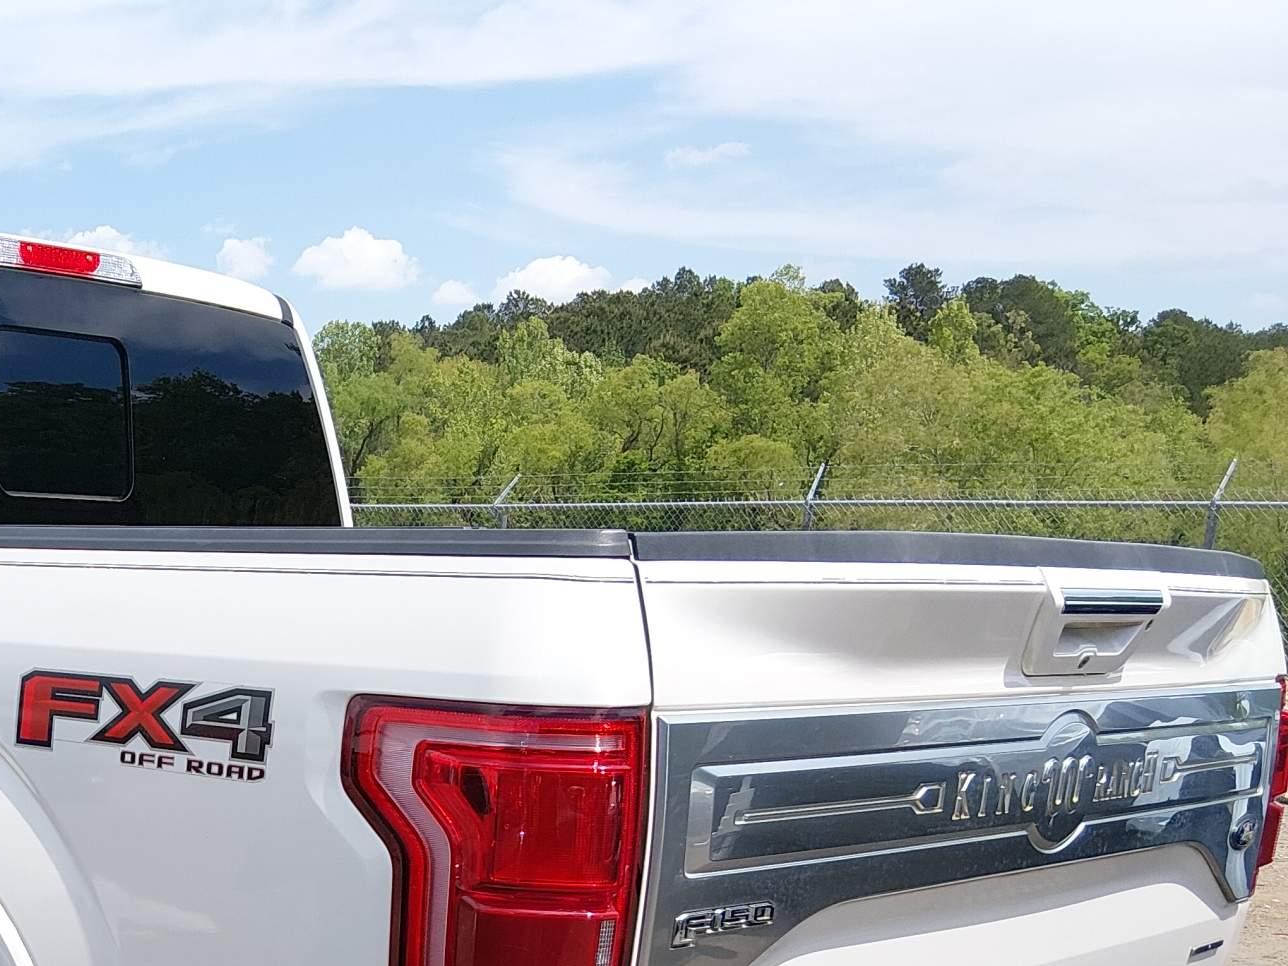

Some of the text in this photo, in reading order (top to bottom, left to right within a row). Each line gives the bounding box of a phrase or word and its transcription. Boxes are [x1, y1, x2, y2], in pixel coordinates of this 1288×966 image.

[16, 670, 272, 762] FX4
[120, 750, 265, 781] OFF ROAD
[951, 751, 1158, 820] KING RANCH
